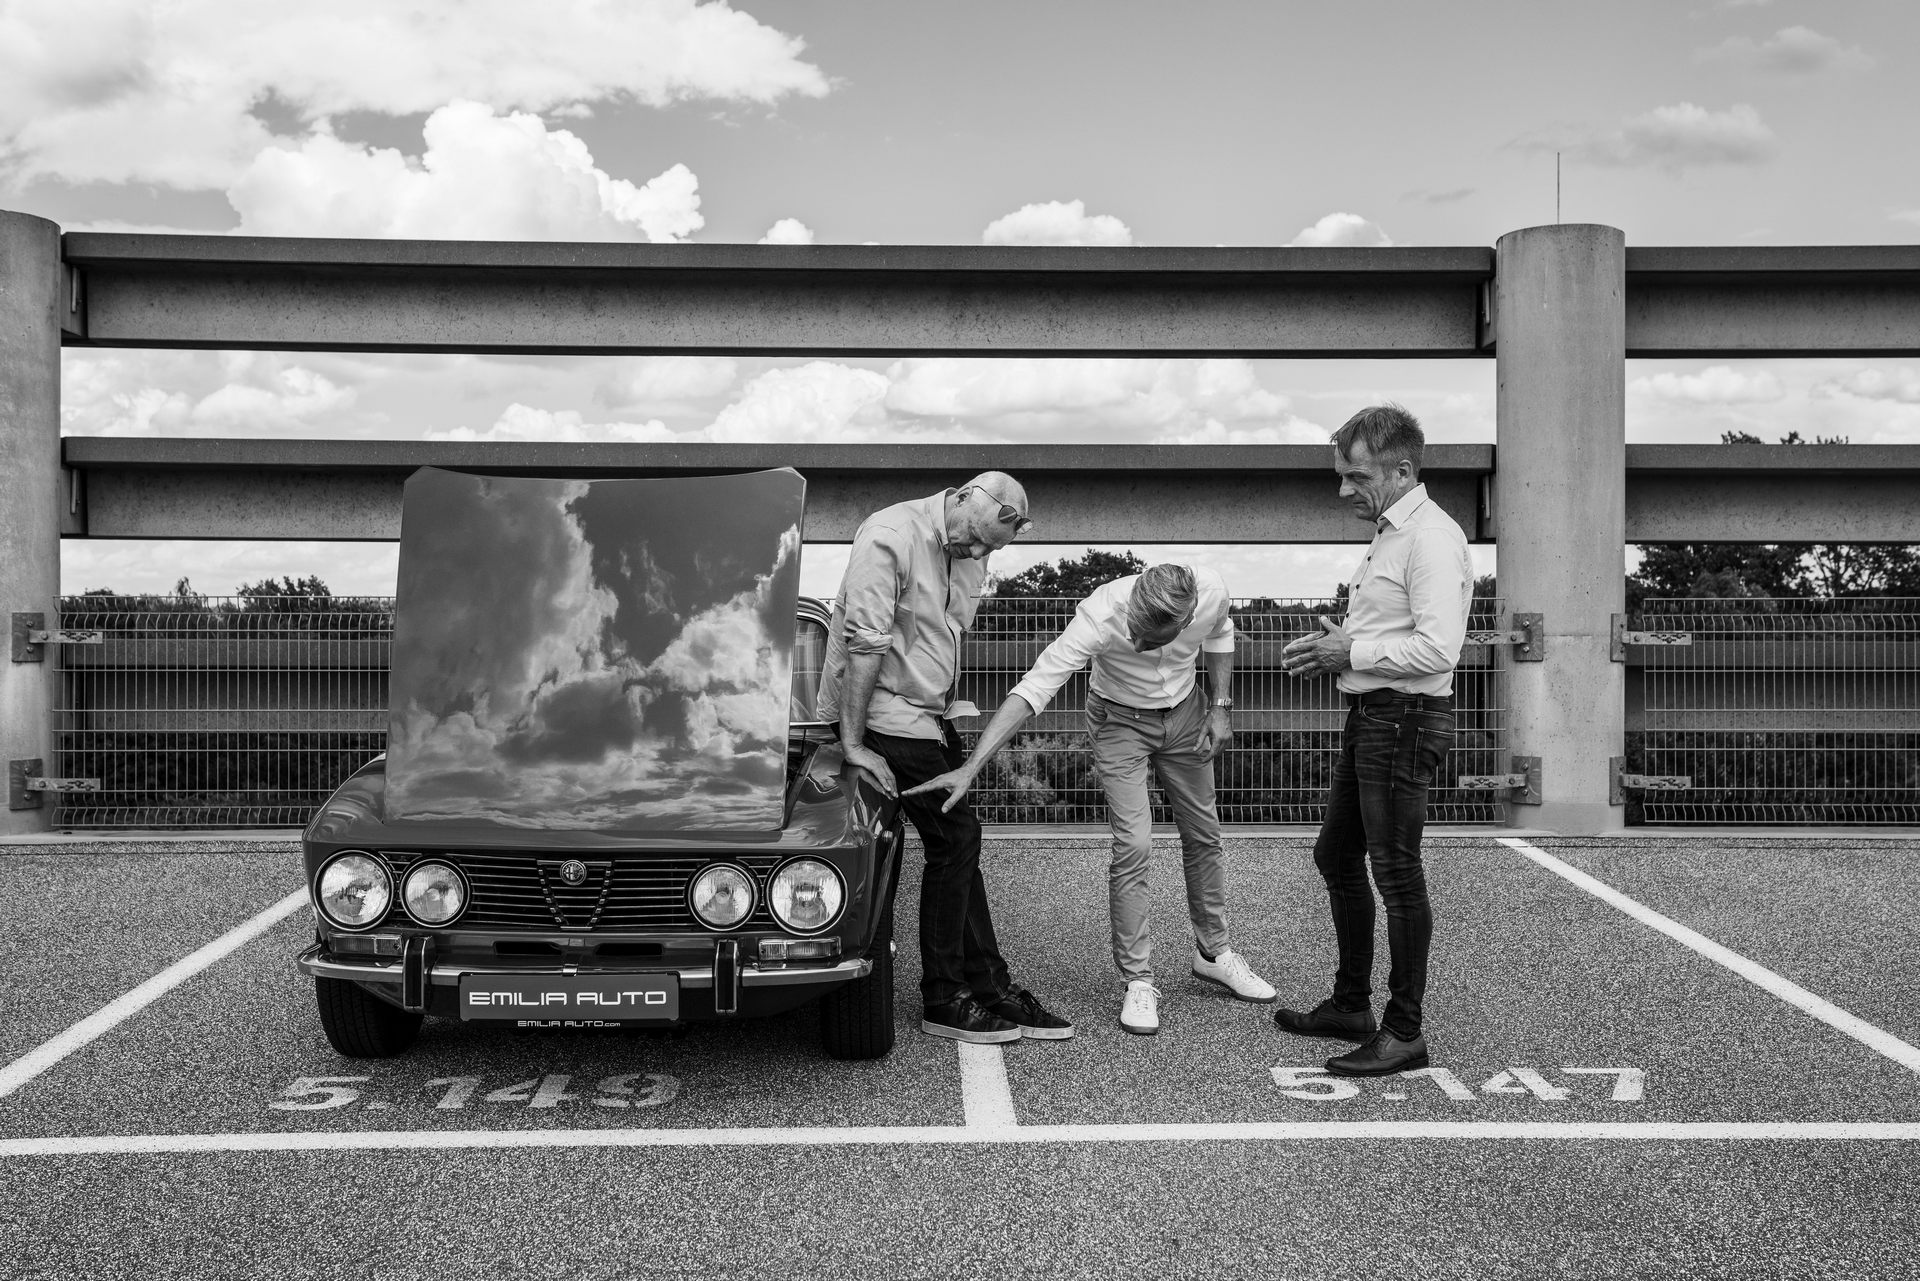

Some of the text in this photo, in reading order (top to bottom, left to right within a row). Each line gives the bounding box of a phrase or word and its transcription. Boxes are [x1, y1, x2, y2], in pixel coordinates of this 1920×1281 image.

[469, 991, 667, 1006] EMILIA AUTO
[269, 1073, 681, 1111] 5.149
[1269, 1066, 1646, 1101] 5.147
